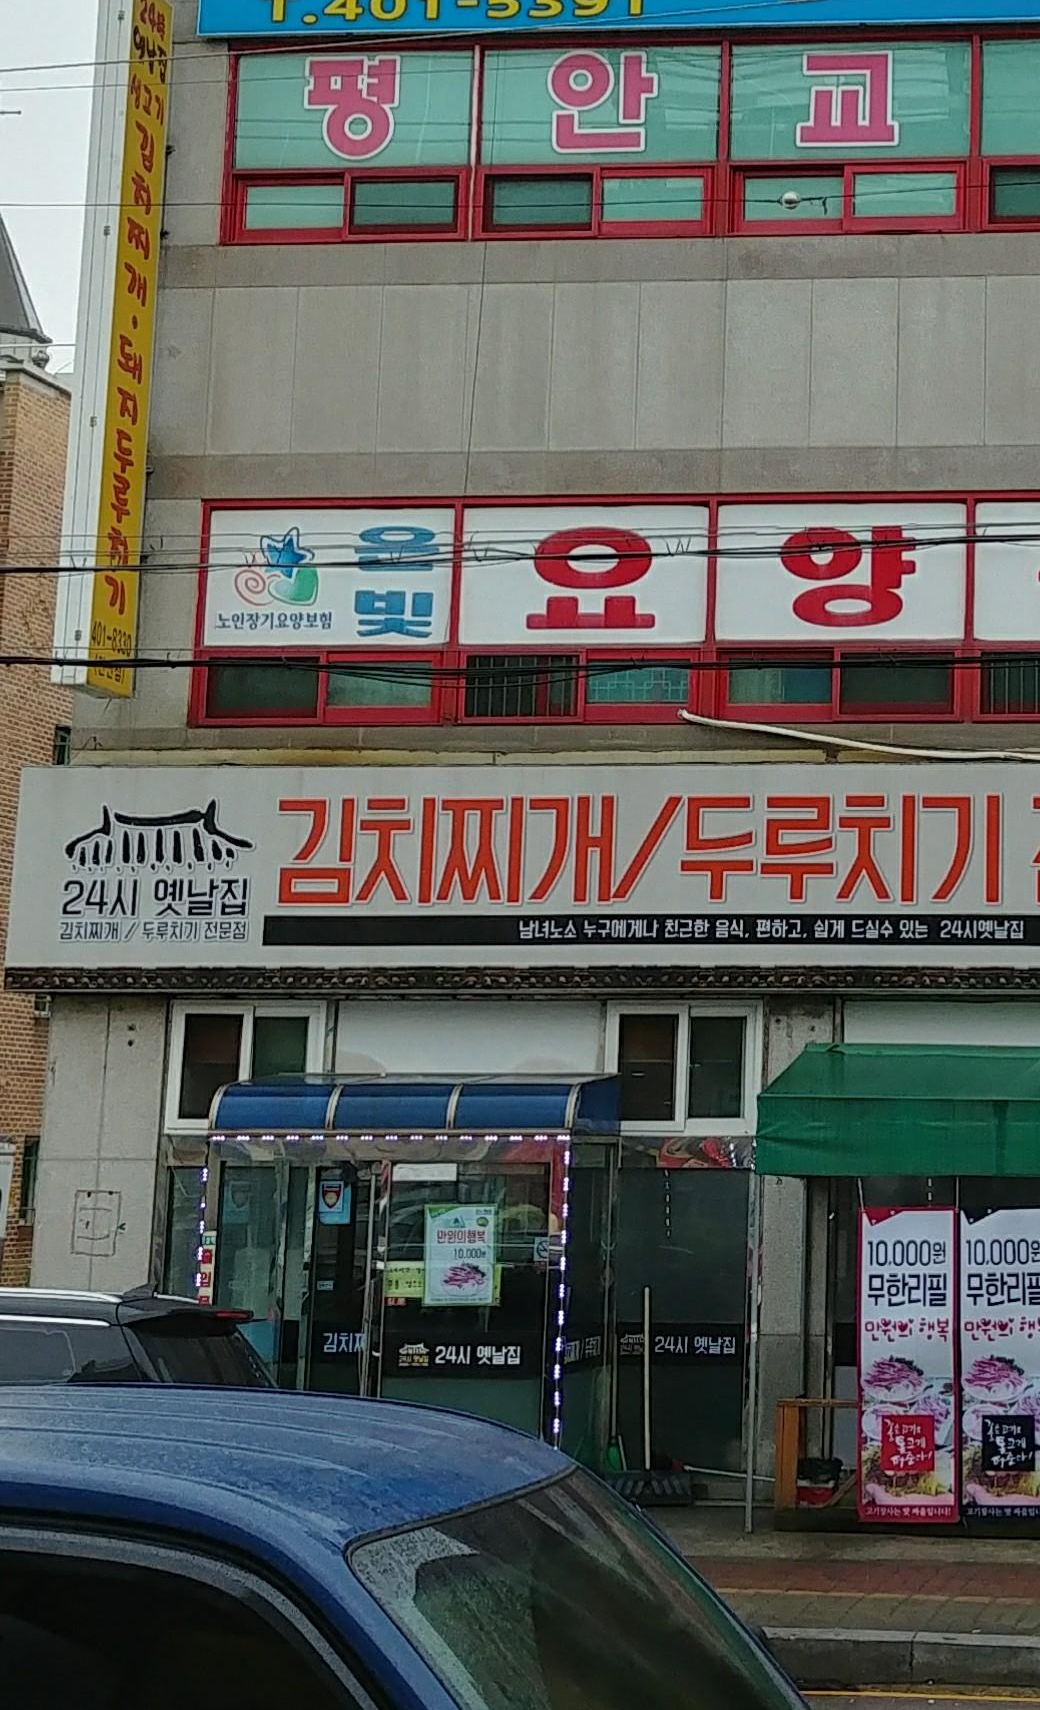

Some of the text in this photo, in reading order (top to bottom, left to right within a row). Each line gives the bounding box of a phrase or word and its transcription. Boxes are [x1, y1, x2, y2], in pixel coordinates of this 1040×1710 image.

[214, 611, 333, 631] 노인장기요양보험
[92, 620, 132, 658] 401-8330
[62, 877, 249, 918] 24시 옛날집
[58, 921, 120, 942] 김치찌개
[141, 921, 199, 941] 두루치기
[204, 921, 249, 941] 전문점
[517, 918, 578, 940] 남녀노소
[582, 918, 659, 940] 누구에게나
[664, 918, 709, 940] 친근한
[714, 918, 751, 940] 음식,
[755, 918, 809, 940] 편하고,
[814, 918, 845, 940] 쉽게
[899, 918, 929, 940] 있는
[867, 1240, 947, 1267] 10,000원
[867, 1273, 948, 1307] 무한리필
[864, 1316, 950, 1342] 만원의 행복
[964, 1317, 1015, 1342] 만원의
[434, 1345, 521, 1365] 24시 옛날집
[654, 1336, 688, 1354] 24시
[694, 1336, 736, 1355] 옛날집
